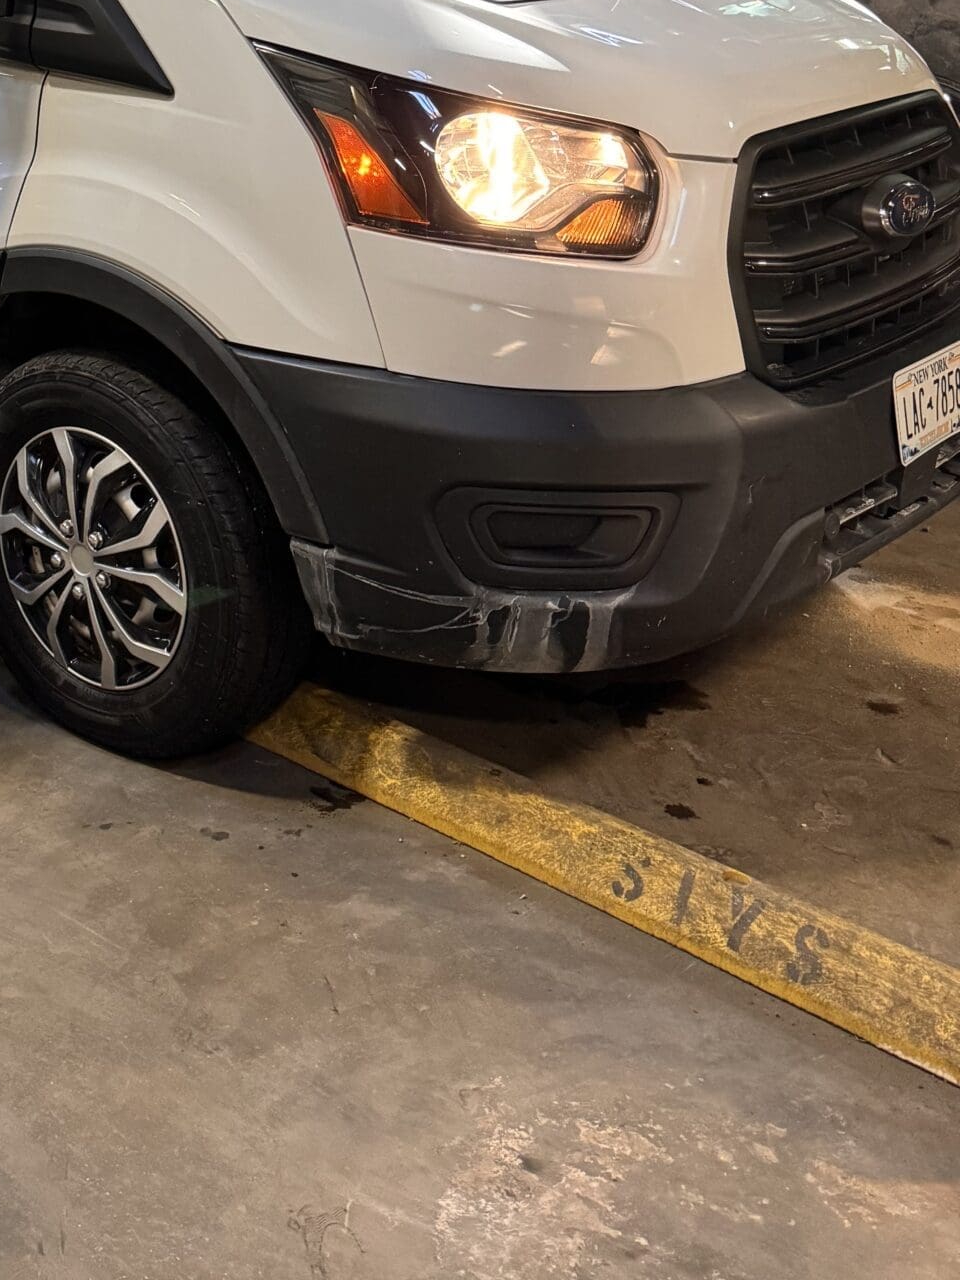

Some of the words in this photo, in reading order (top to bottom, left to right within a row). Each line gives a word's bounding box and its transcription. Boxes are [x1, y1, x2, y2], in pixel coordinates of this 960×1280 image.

[912, 366, 929, 387] NEW
[929, 356, 949, 378] YORK
[903, 387, 926, 441] LAC
